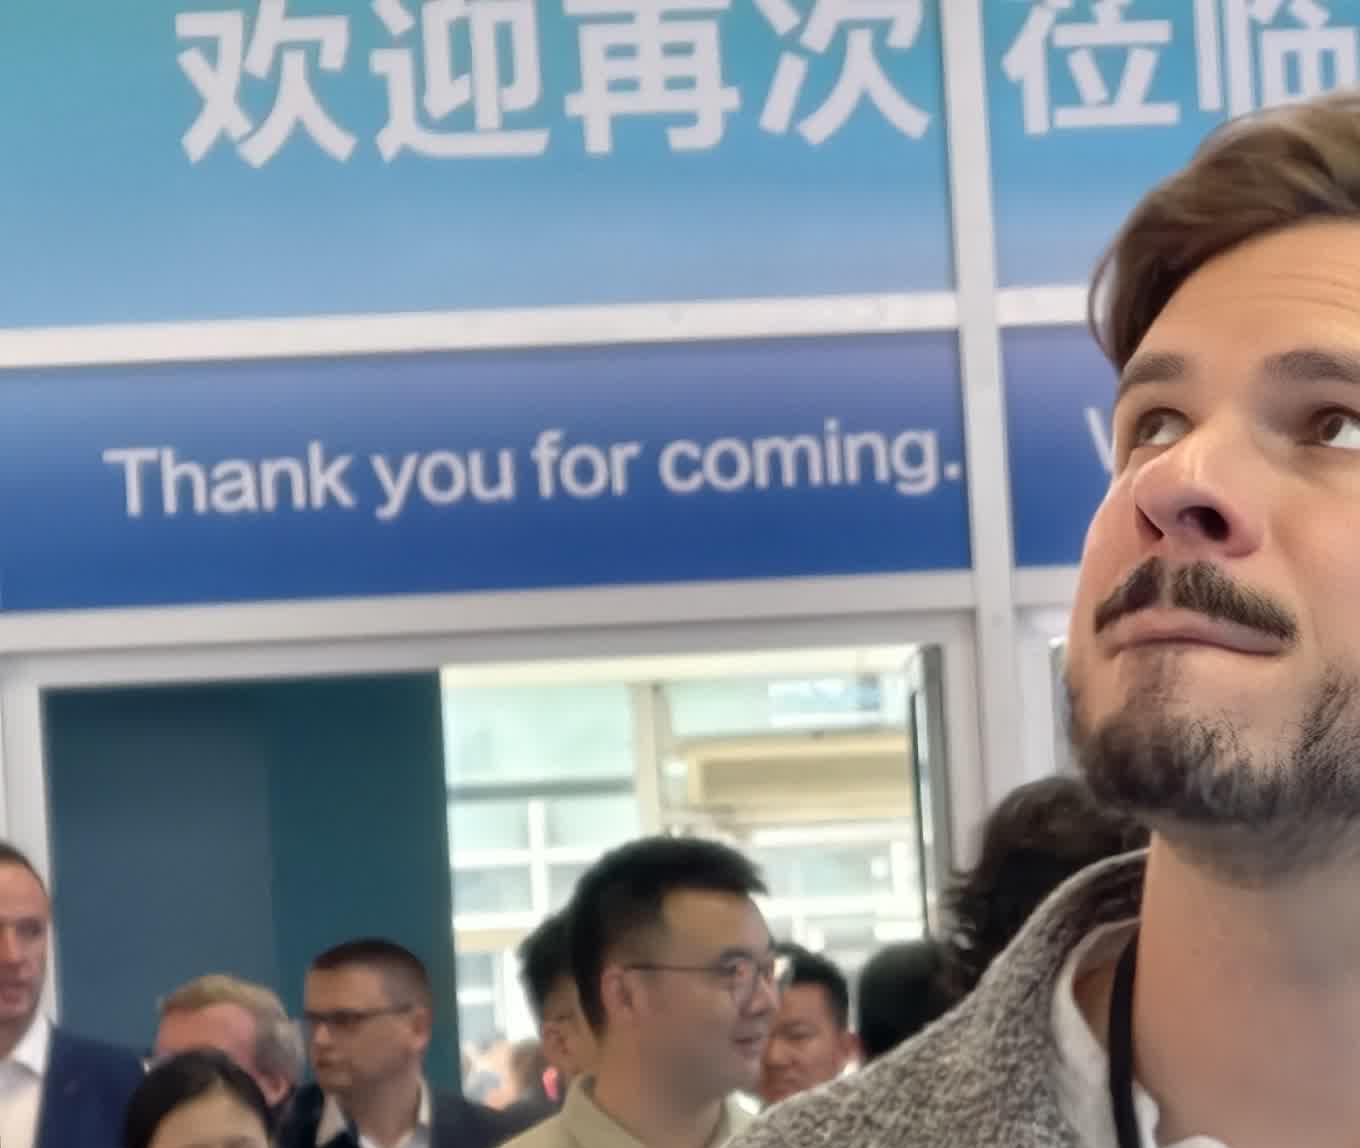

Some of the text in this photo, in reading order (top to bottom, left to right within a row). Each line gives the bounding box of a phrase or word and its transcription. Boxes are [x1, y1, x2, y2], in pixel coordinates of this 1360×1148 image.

[103, 442, 356, 518] Thank
[373, 449, 515, 521] you
[530, 431, 641, 500] for
[658, 418, 960, 496] coming.
